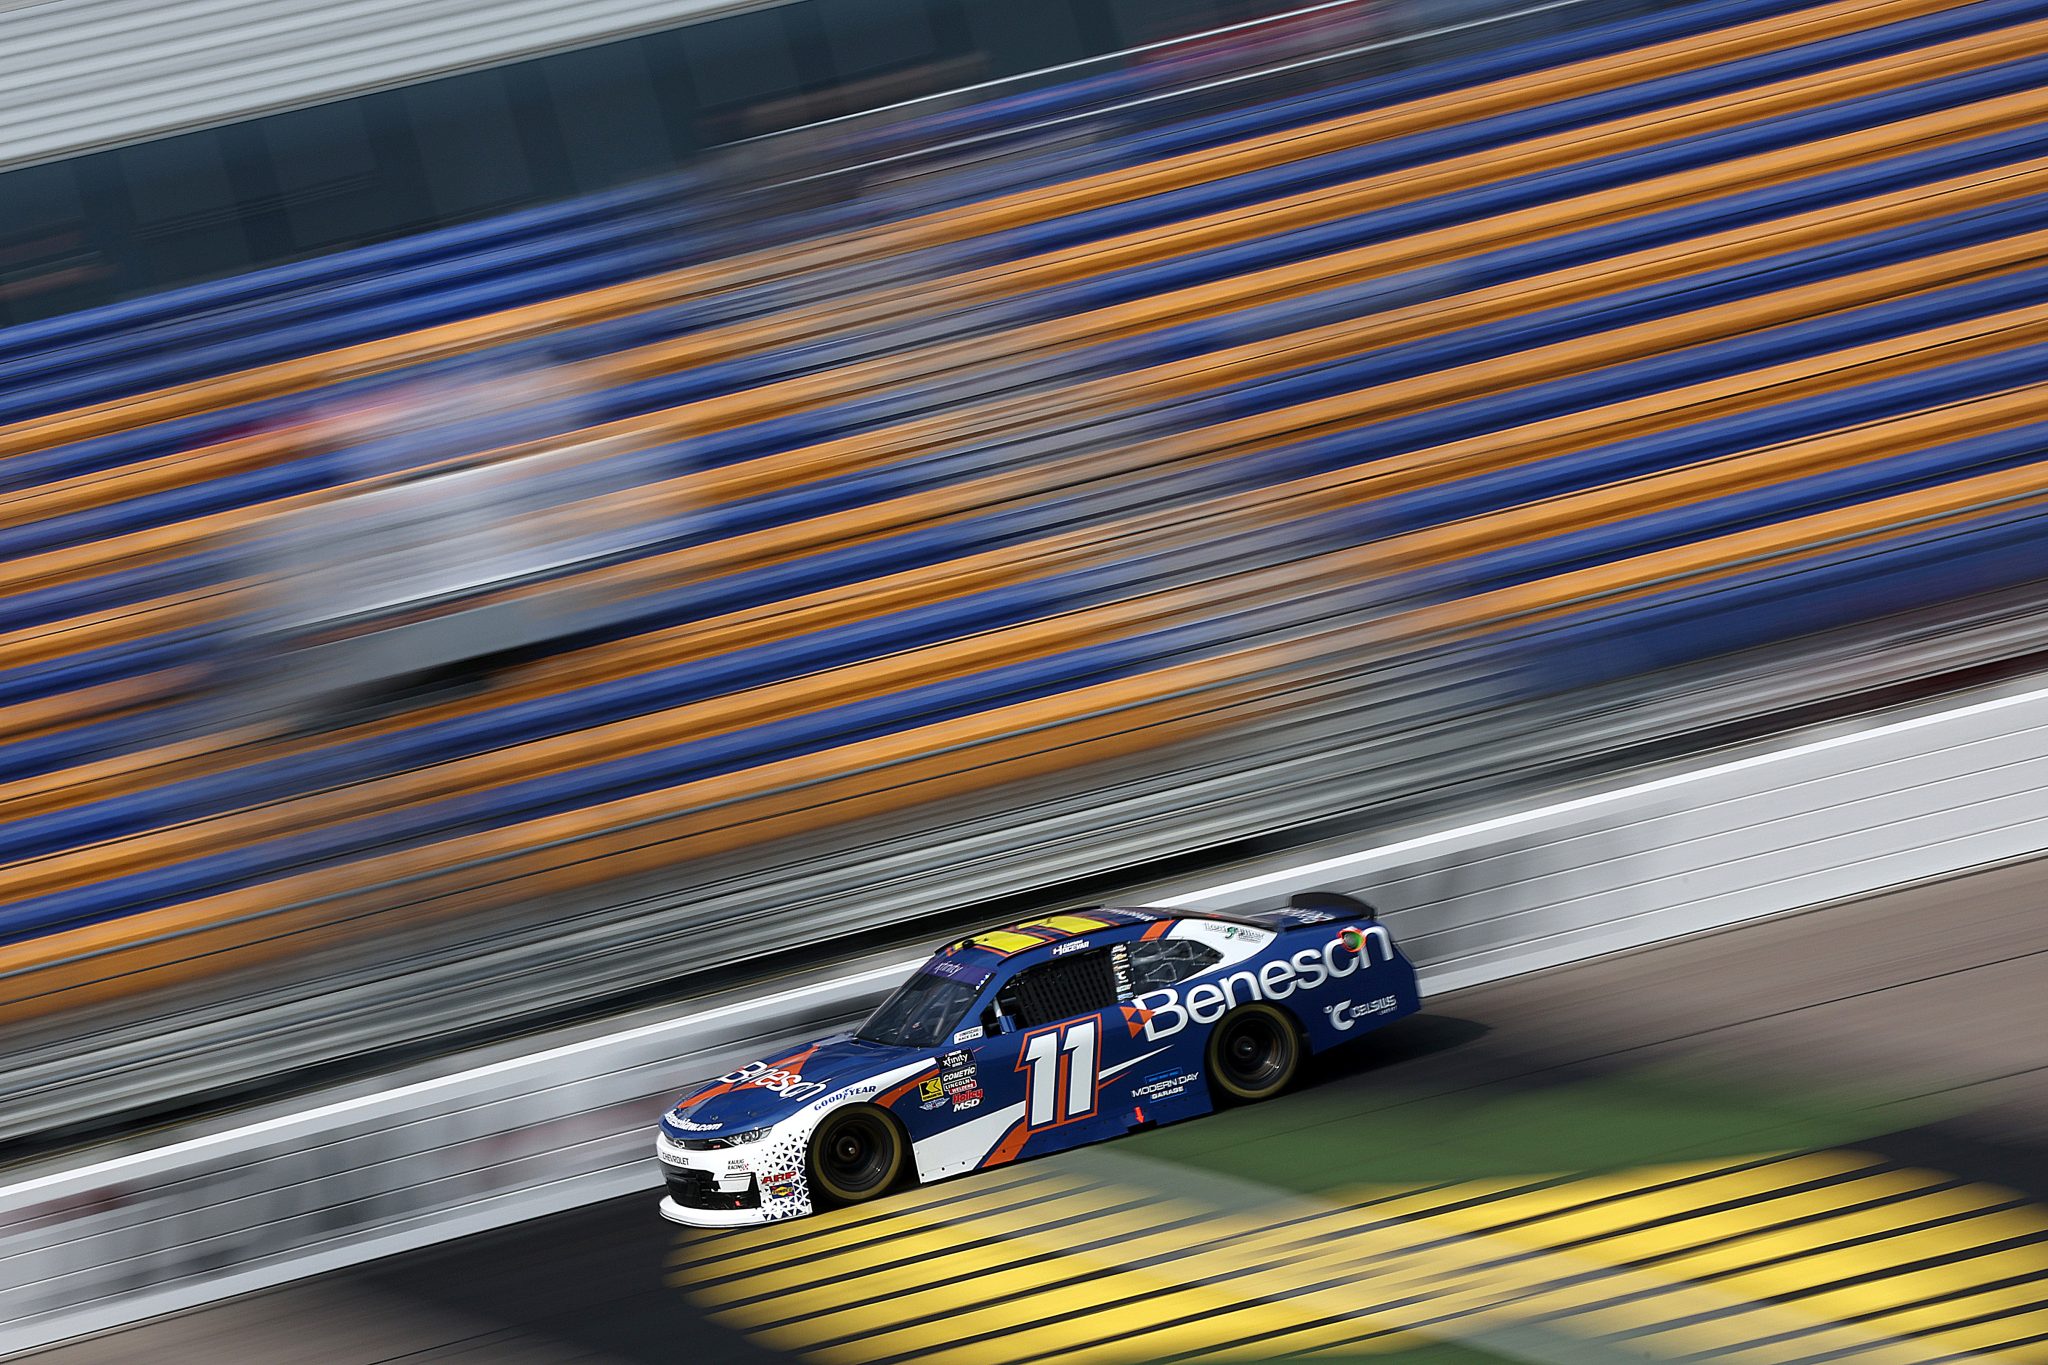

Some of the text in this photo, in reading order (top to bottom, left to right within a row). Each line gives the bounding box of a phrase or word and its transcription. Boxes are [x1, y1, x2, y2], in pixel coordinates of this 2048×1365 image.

[942, 1053, 968, 1068] xfinity
[1025, 1020, 1096, 1127] 11
[945, 1078, 970, 1090] LINCOLN
[1131, 1071, 1199, 1098] MODERN DAY
[1151, 1086, 1184, 1100] GARAGE
[953, 1099, 980, 1113] MSD
[761, 1171, 797, 1185] ARP
